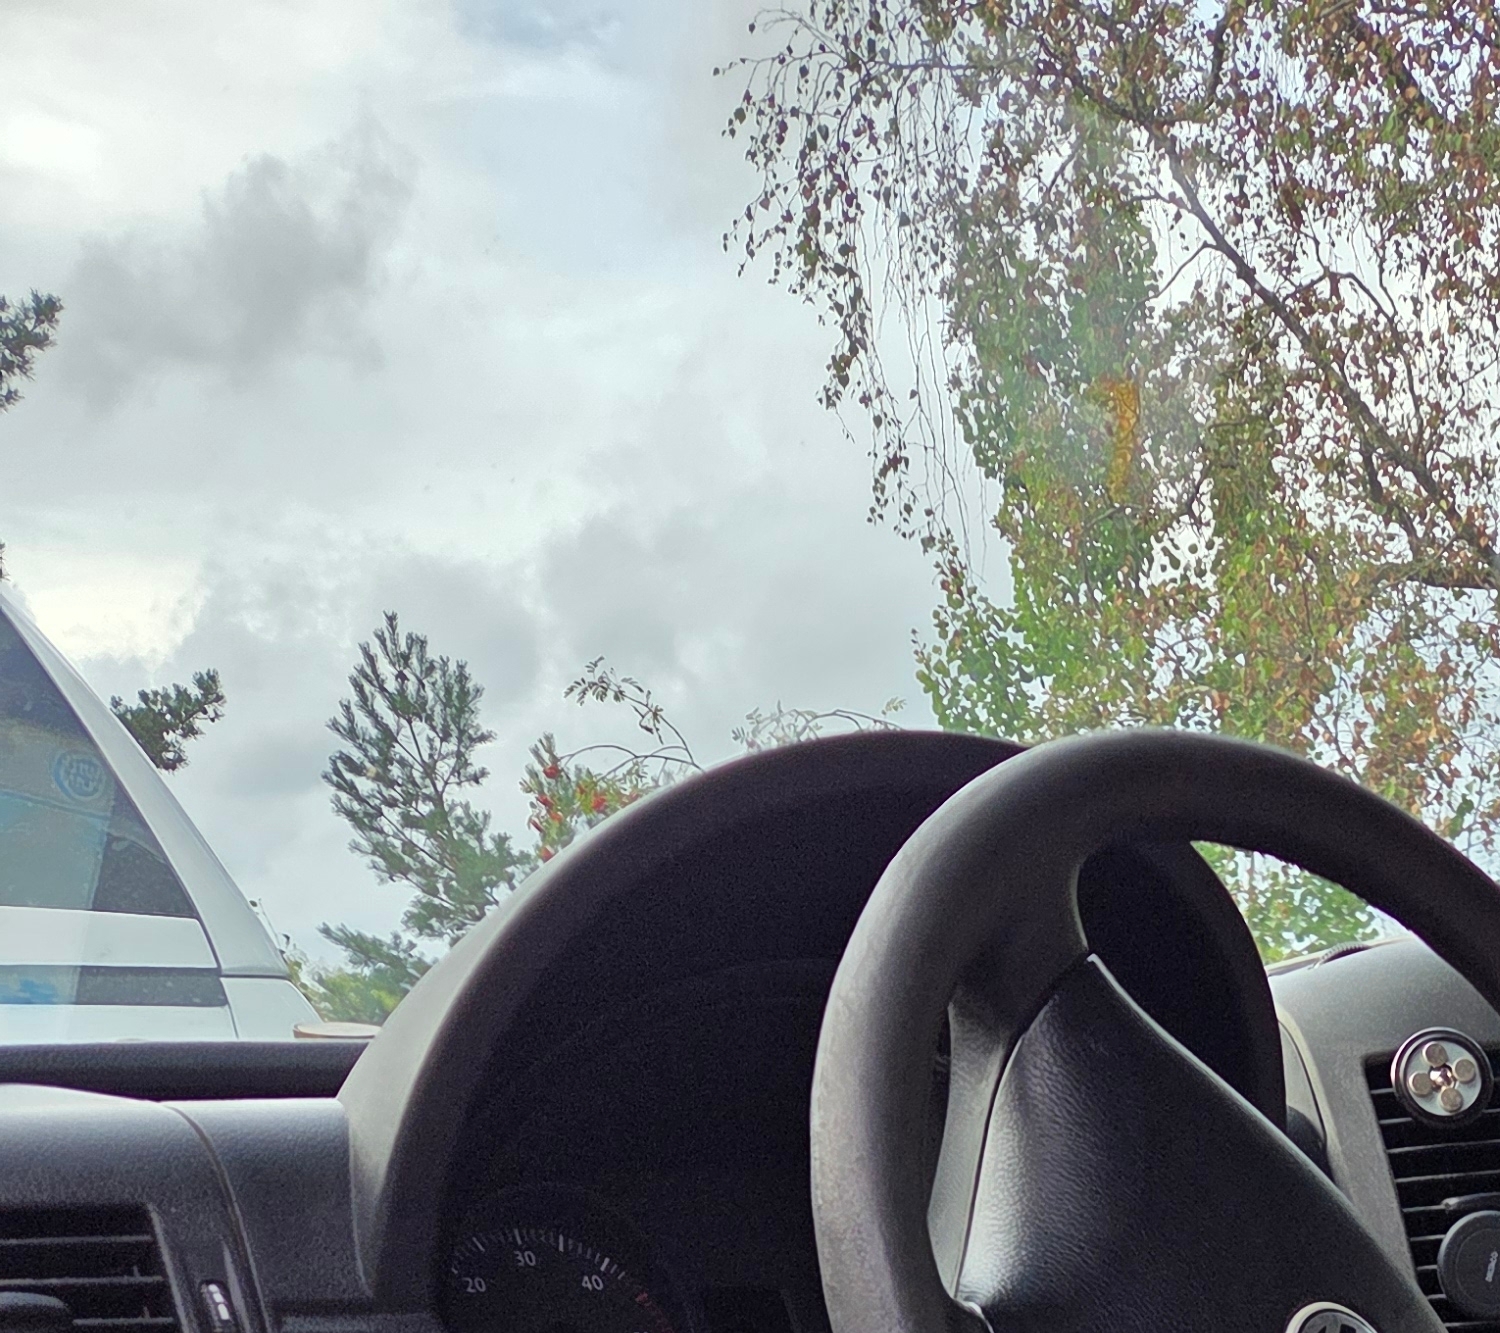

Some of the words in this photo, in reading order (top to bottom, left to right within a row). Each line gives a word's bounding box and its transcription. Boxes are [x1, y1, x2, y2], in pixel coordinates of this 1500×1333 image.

[514, 1251, 536, 1267] 30
[464, 1277, 486, 1293] 20
[582, 1275, 604, 1291] 40
